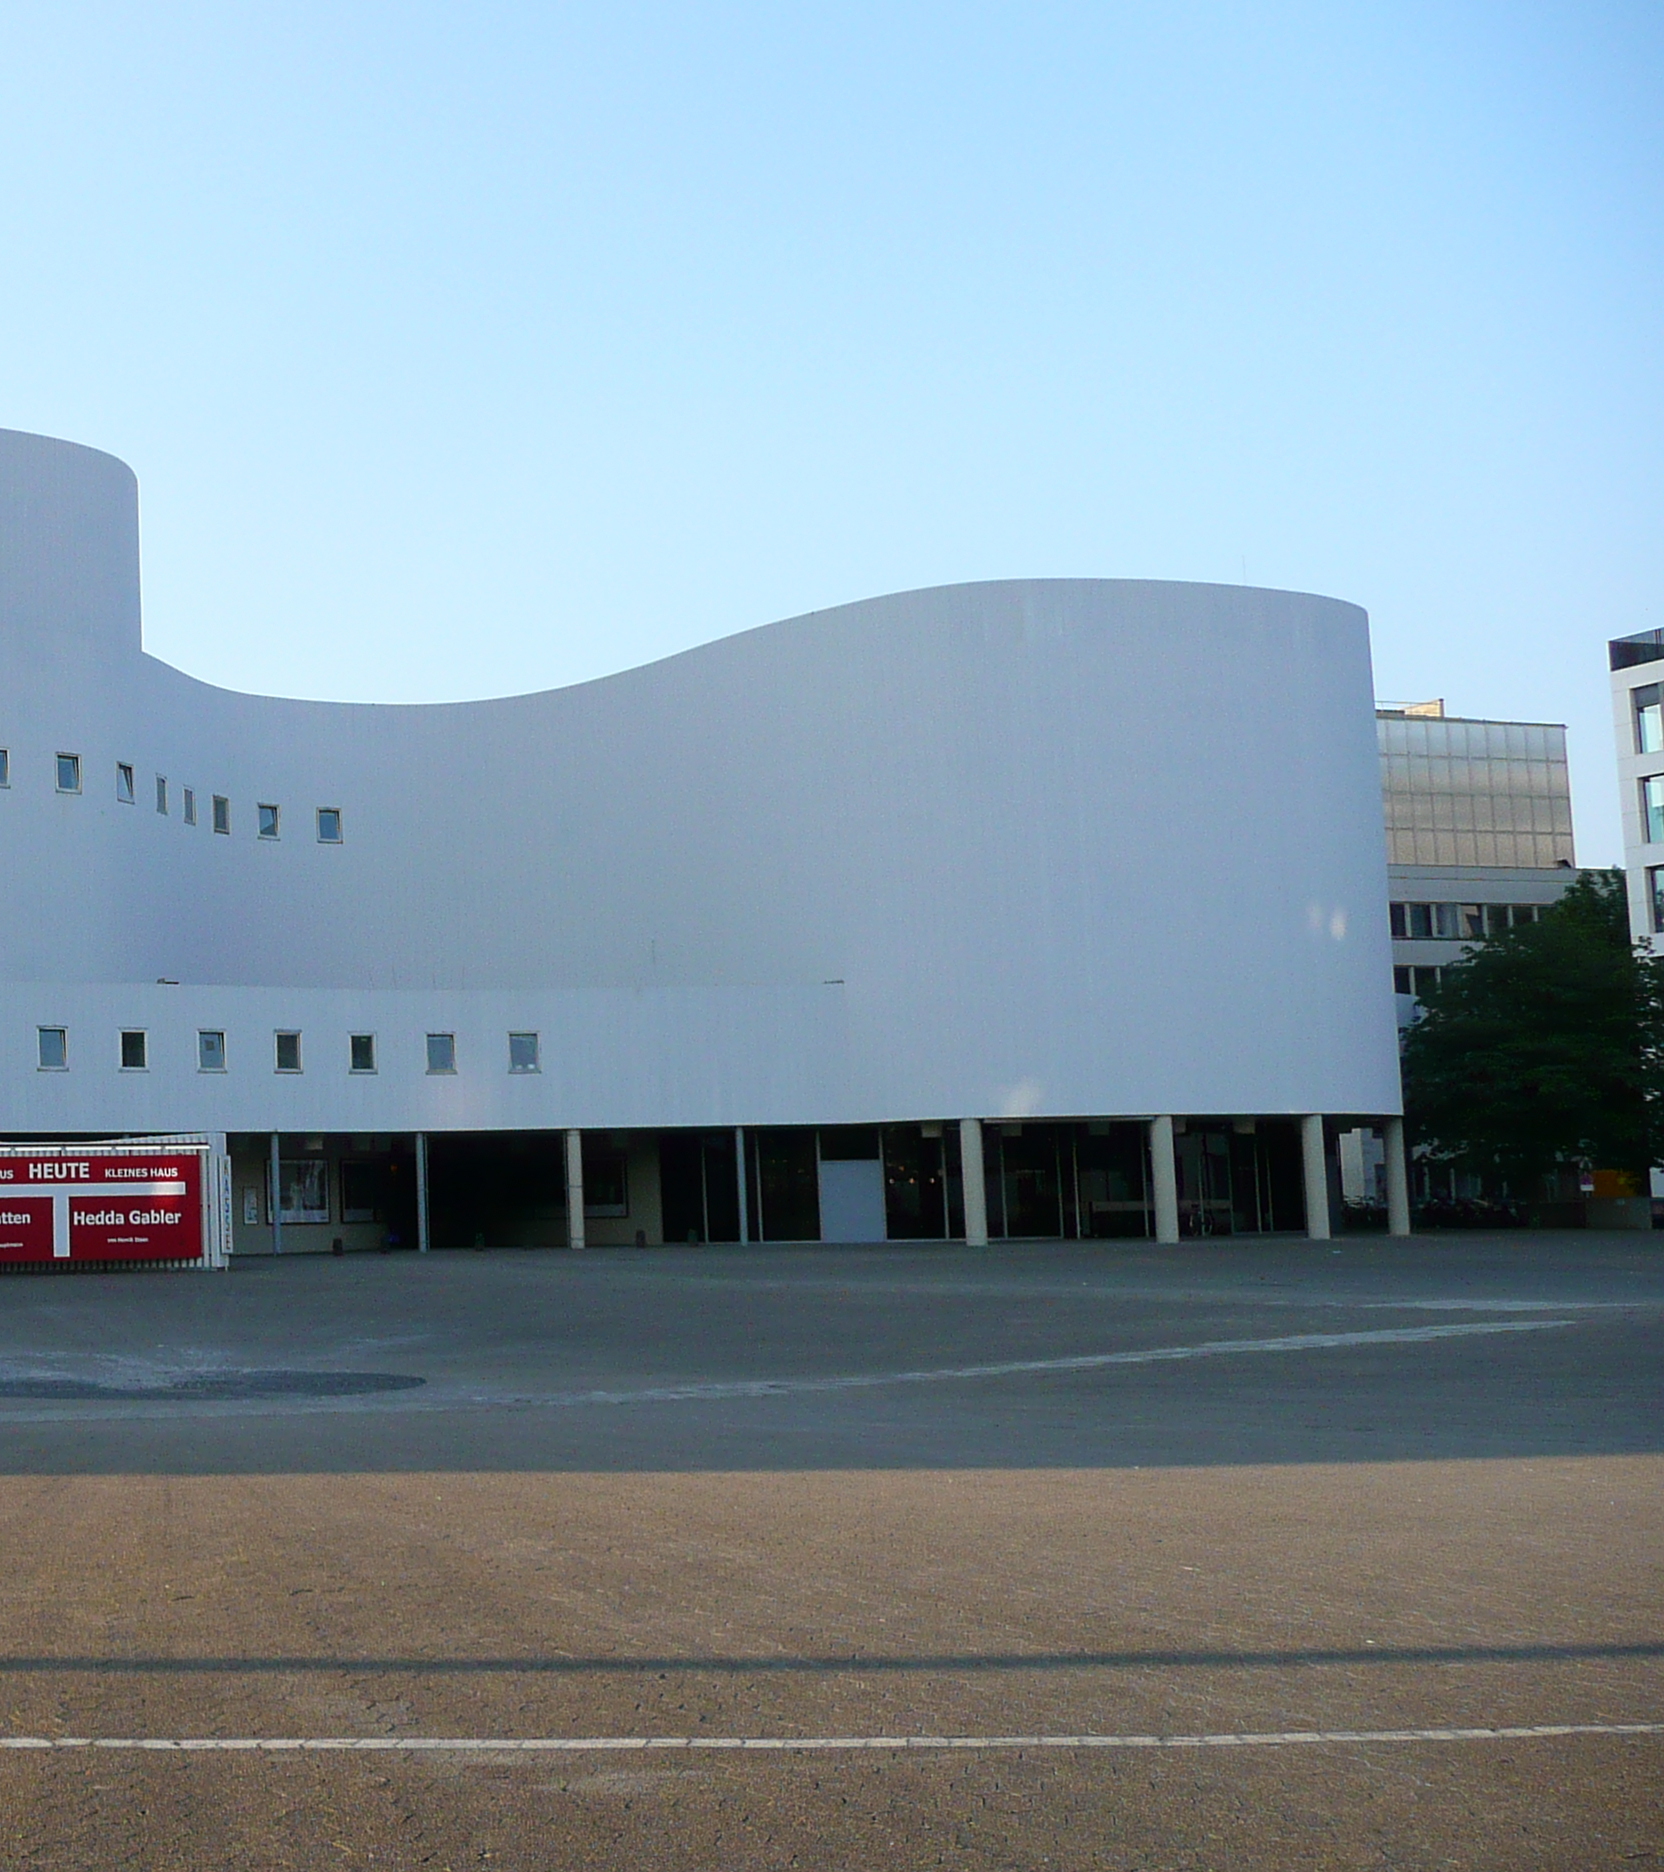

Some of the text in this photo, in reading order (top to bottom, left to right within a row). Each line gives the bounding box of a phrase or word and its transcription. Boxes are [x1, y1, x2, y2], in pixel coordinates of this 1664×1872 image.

[29, 1162, 90, 1179] HEUTE
[105, 1167, 178, 1178] KLEINES HAUS
[73, 1209, 182, 1226] Hedda Gabler
